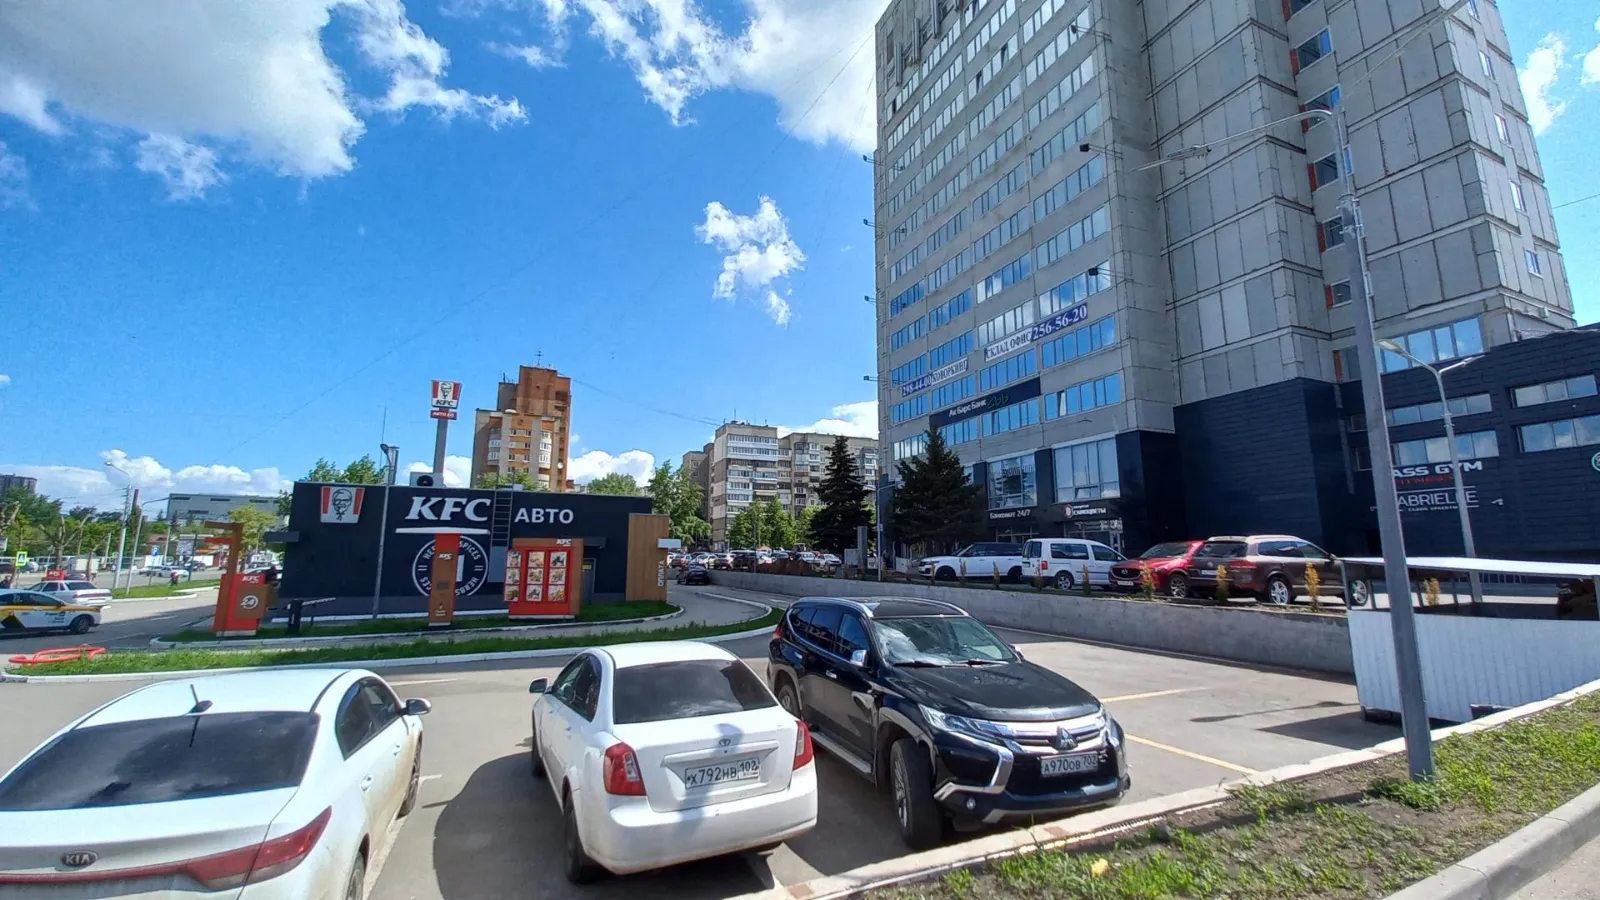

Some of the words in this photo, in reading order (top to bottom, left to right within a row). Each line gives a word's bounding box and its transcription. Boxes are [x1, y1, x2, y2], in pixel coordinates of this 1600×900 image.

[986, 341, 1009, 359] СКЛАД
[1010, 331, 1031, 349] ОФИС
[1033, 305, 1088, 340] 256-56-20
[932, 360, 968, 384] КОВОРКИНГ
[971, 399, 987, 410] Банк
[1392, 466, 1430, 478] ASS
[1397, 490, 1479, 507] ABRIELE
[405, 496, 491, 522] KFC
[514, 507, 574, 524] АВТО
[989, 510, 1016, 519] Банкомат
[1017, 508, 1031, 517] 24/7
[459, 540, 481, 560] SPICES
[657, 560, 665, 587] ОПЛАТА
[455, 576, 479, 596] HERBS
[739, 760, 758, 772] 102
[65, 854, 90, 865] KIA
